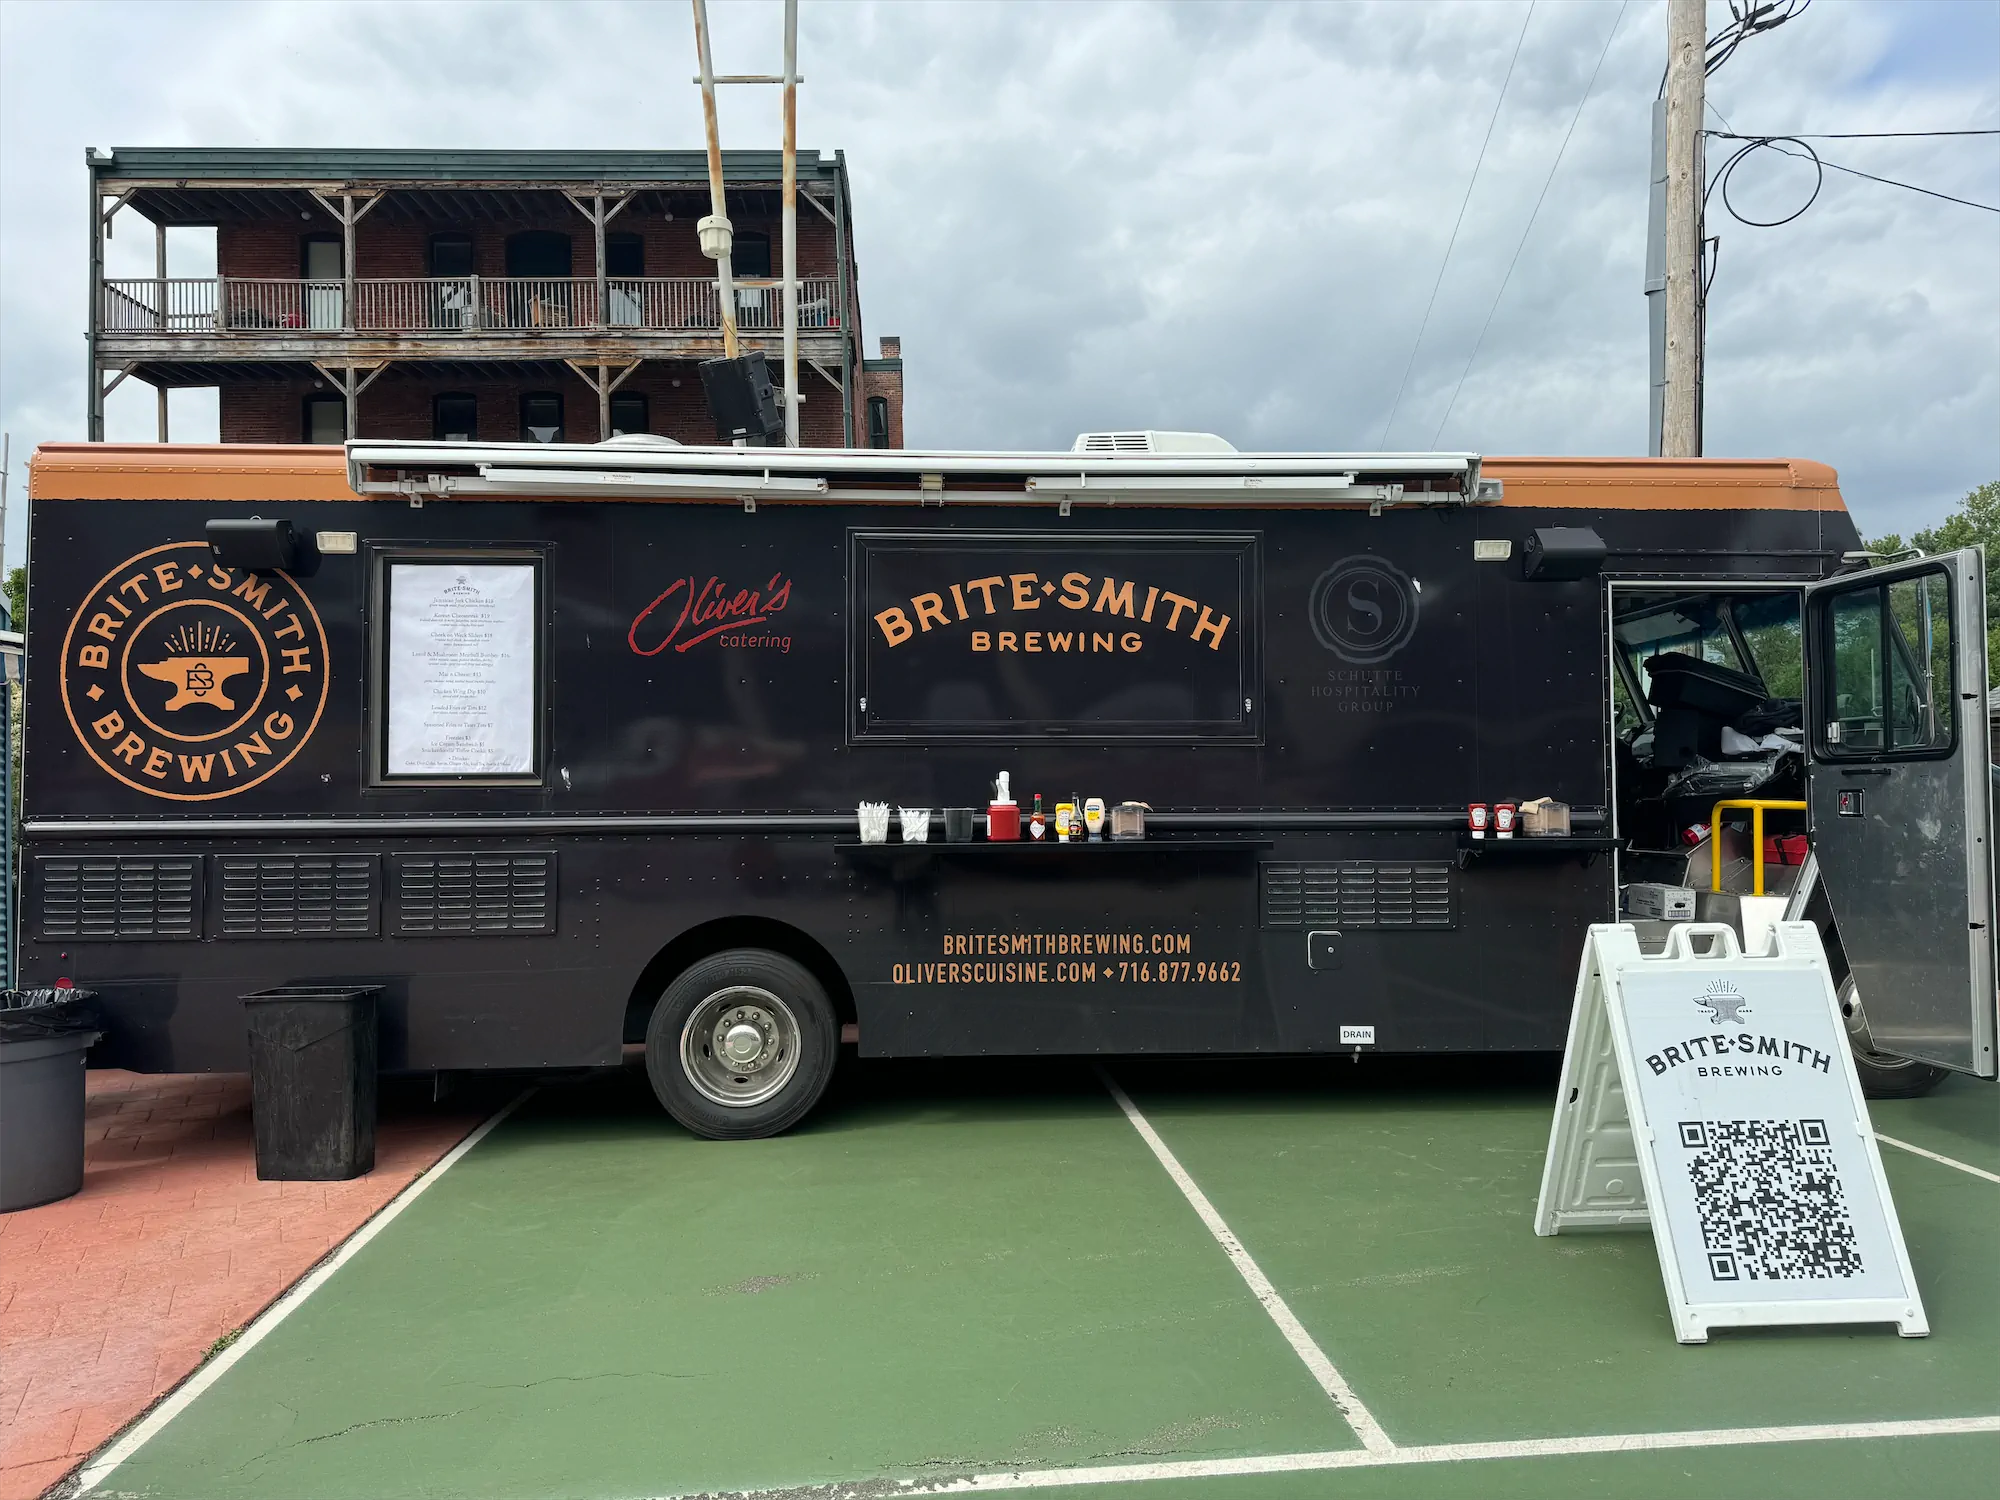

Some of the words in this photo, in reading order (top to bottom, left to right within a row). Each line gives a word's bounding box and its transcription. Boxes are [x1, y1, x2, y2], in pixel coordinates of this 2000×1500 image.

[79, 561, 183, 670] BRITE
[207, 563, 311, 675] SMITH
[627, 571, 792, 656] Oliver's
[873, 572, 1041, 648] BRITE
[1057, 571, 1232, 651] SMITH
[719, 632, 792, 654] catering
[971, 631, 1143, 653] BREWING
[1328, 670, 1403, 681] SCHUTTE
[1311, 686, 1421, 697] HOSPITALITY
[1338, 701, 1393, 713] GROUP
[92, 710, 294, 783] BREWING
[943, 933, 1192, 955] BRITESMITHBREWING.COM
[892, 961, 1096, 984] OLIVERSCUISINE.COM
[1118, 961, 1242, 983] 716.877.9662
[1343, 1030, 1372, 1038] DRAIN
[1645, 1034, 1730, 1076] BRITE
[1738, 1033, 1832, 1074] SMITH
[1697, 1065, 1783, 1077] BREWING
